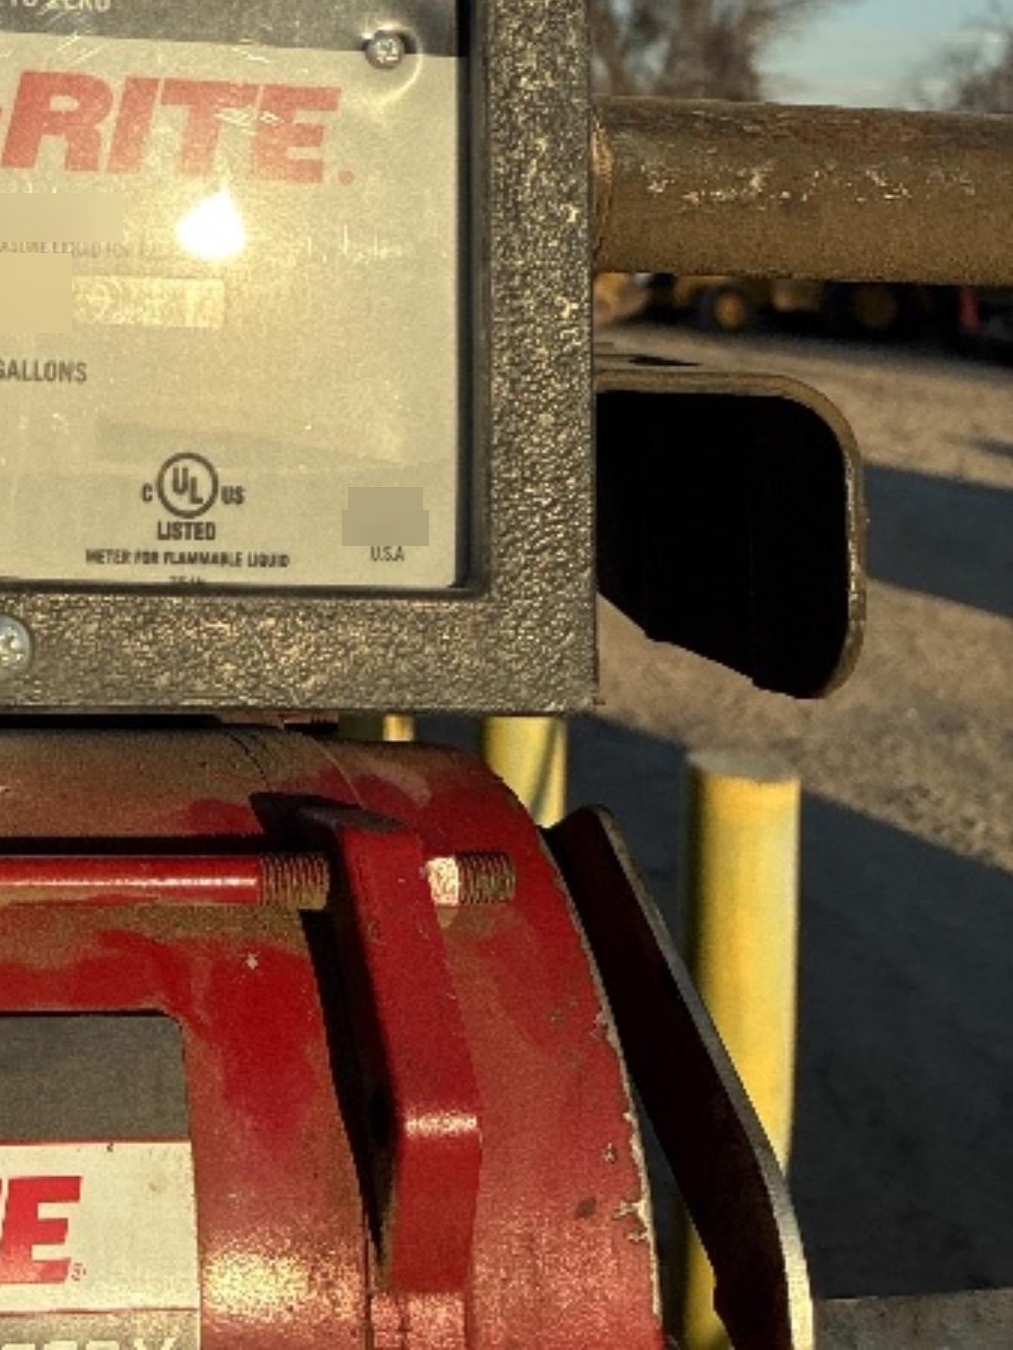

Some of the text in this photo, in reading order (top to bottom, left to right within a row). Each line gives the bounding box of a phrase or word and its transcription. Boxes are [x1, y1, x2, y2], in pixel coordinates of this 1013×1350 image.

[172, 466, 204, 505] UL
[221, 485, 245, 506] US
[157, 521, 216, 541] LISTED
[85, 549, 131, 565] METER
[134, 550, 159, 565] FOR
[163, 551, 243, 567] FLAMMABLE
